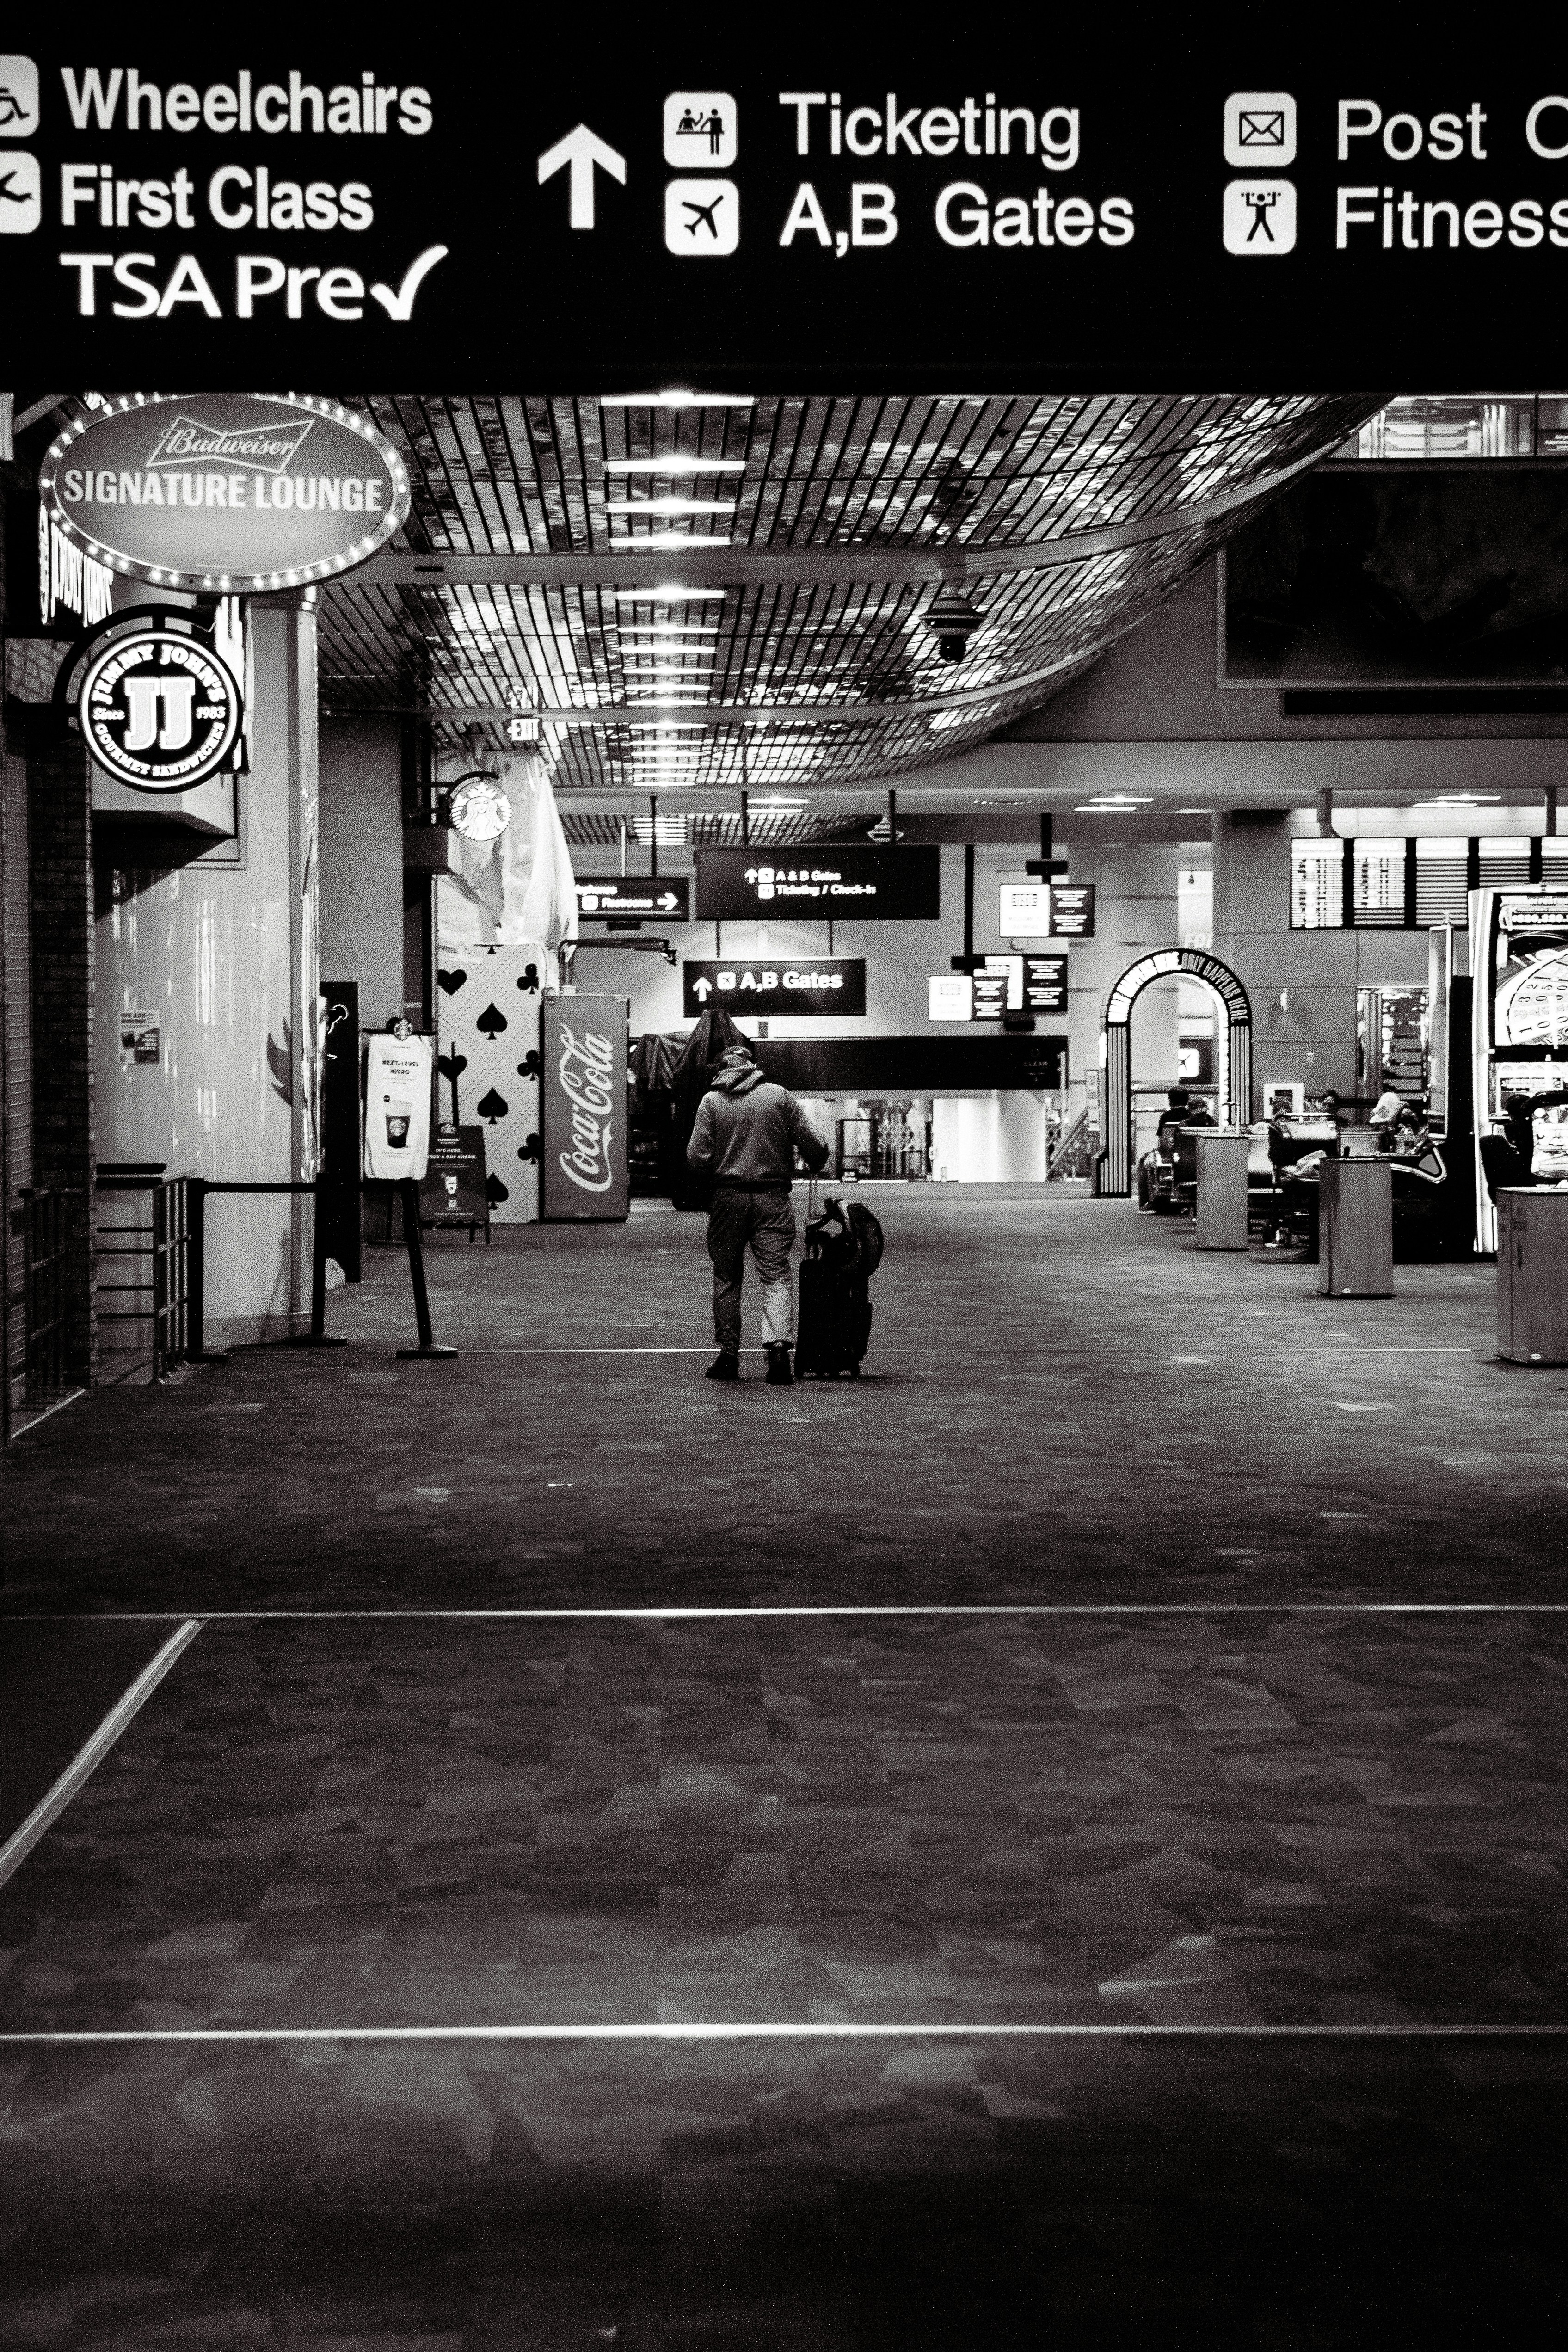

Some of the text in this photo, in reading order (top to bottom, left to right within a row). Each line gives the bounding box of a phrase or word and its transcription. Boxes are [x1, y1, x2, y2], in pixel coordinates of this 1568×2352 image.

[61, 67, 433, 135] Wheelchairs
[1338, 99, 1488, 160] Post
[779, 92, 1080, 171] Ticketing
[61, 163, 374, 231] First Class
[779, 181, 1135, 258] A,B Gates
[59, 252, 222, 318] TSA
[161, 429, 296, 455] Budweiser
[63, 468, 383, 512] SIGNATURE LOUNGE
[92, 644, 227, 705] JIMMY JOHN'S
[93, 705, 226, 720] Since 1983
[122, 676, 196, 751] JJ
[95, 722, 151, 776] GOURMET
[601, 897, 653, 908] Restrooms
[775, 870, 842, 881] A & B Gates
[775, 884, 820, 897] Ticketing
[822, 884, 829, 894] /
[739, 971, 844, 993] A,B Gates
[1202, 961, 1241, 999] HAPPENS
[560, 1022, 614, 1192] Coca-Cola
